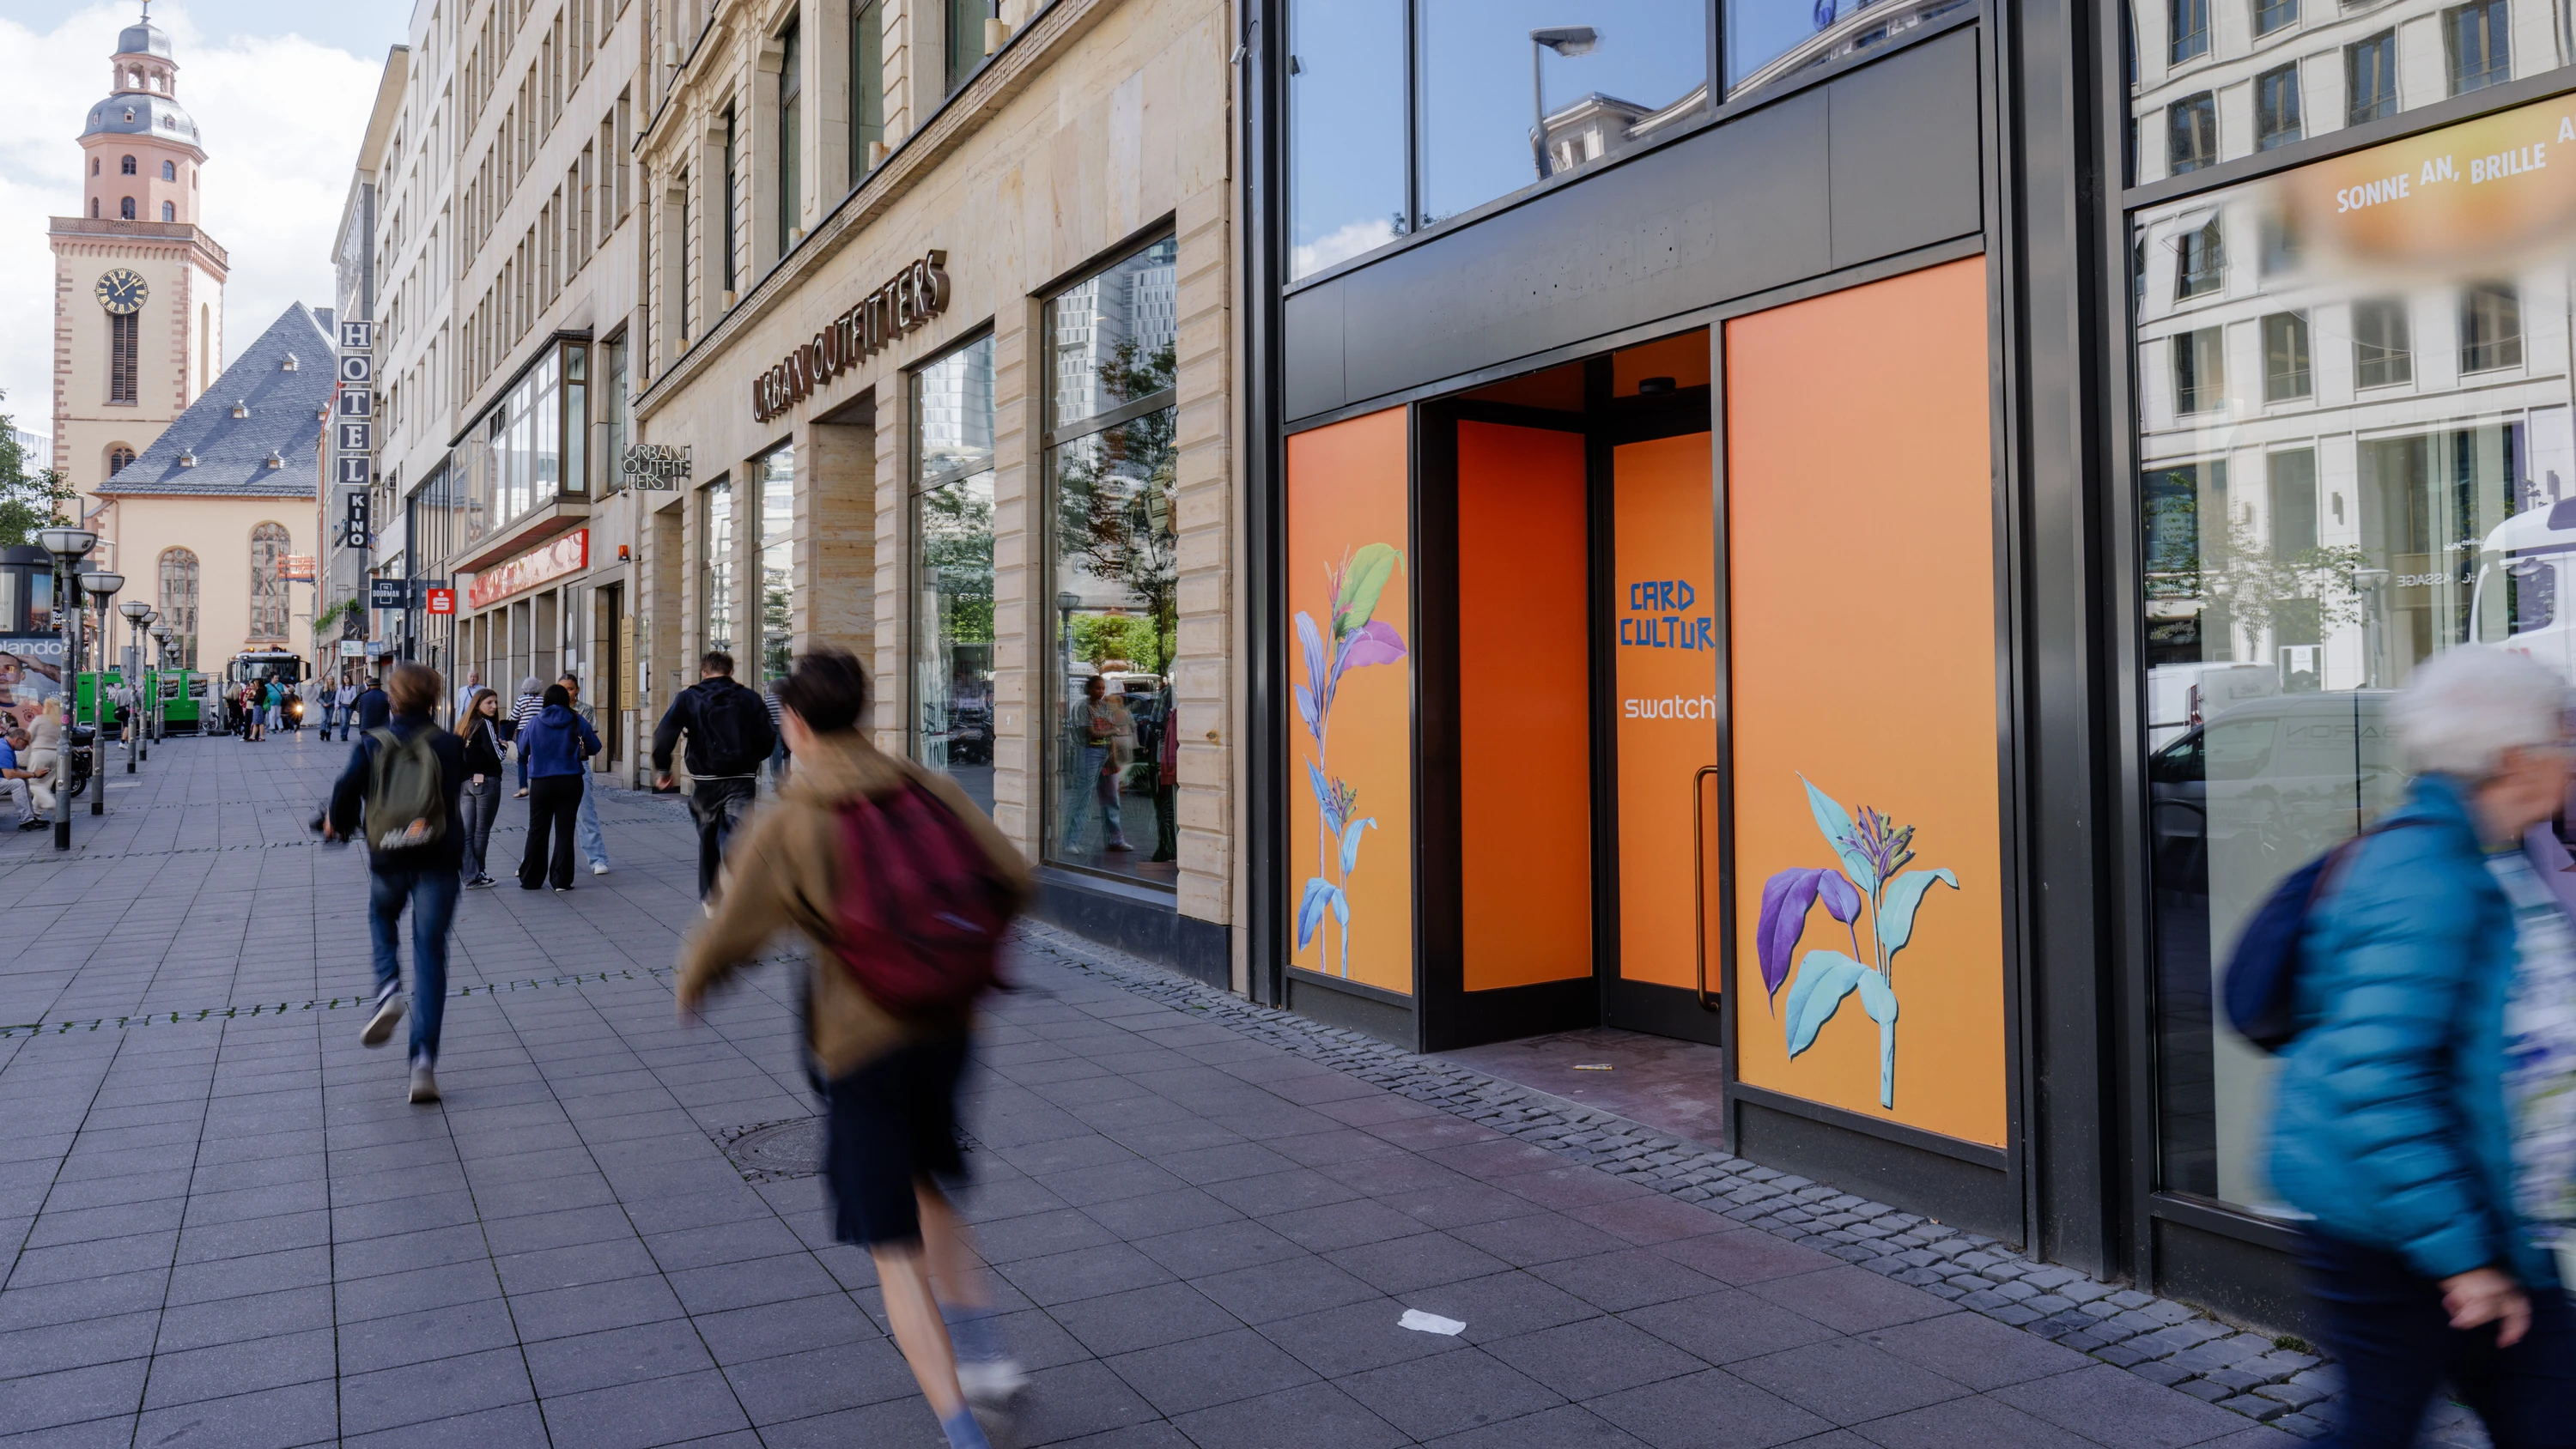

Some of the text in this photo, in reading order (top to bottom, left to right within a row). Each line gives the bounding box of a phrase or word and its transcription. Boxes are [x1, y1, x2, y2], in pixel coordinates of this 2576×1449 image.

[2336, 116, 2576, 213] SONNE AN, BRILLE A
[753, 249, 951, 423] URBAN OUTFITTERS
[342, 324, 368, 482] HOTEL
[623, 445, 684, 461] URBAN
[623, 458, 686, 476] OUTFIT
[625, 473, 665, 489] TERS
[350, 494, 365, 546] KINO
[1631, 579, 1695, 611] CARD
[1620, 616, 1716, 652] CULTUR
[1625, 694, 1716, 719] swatch
